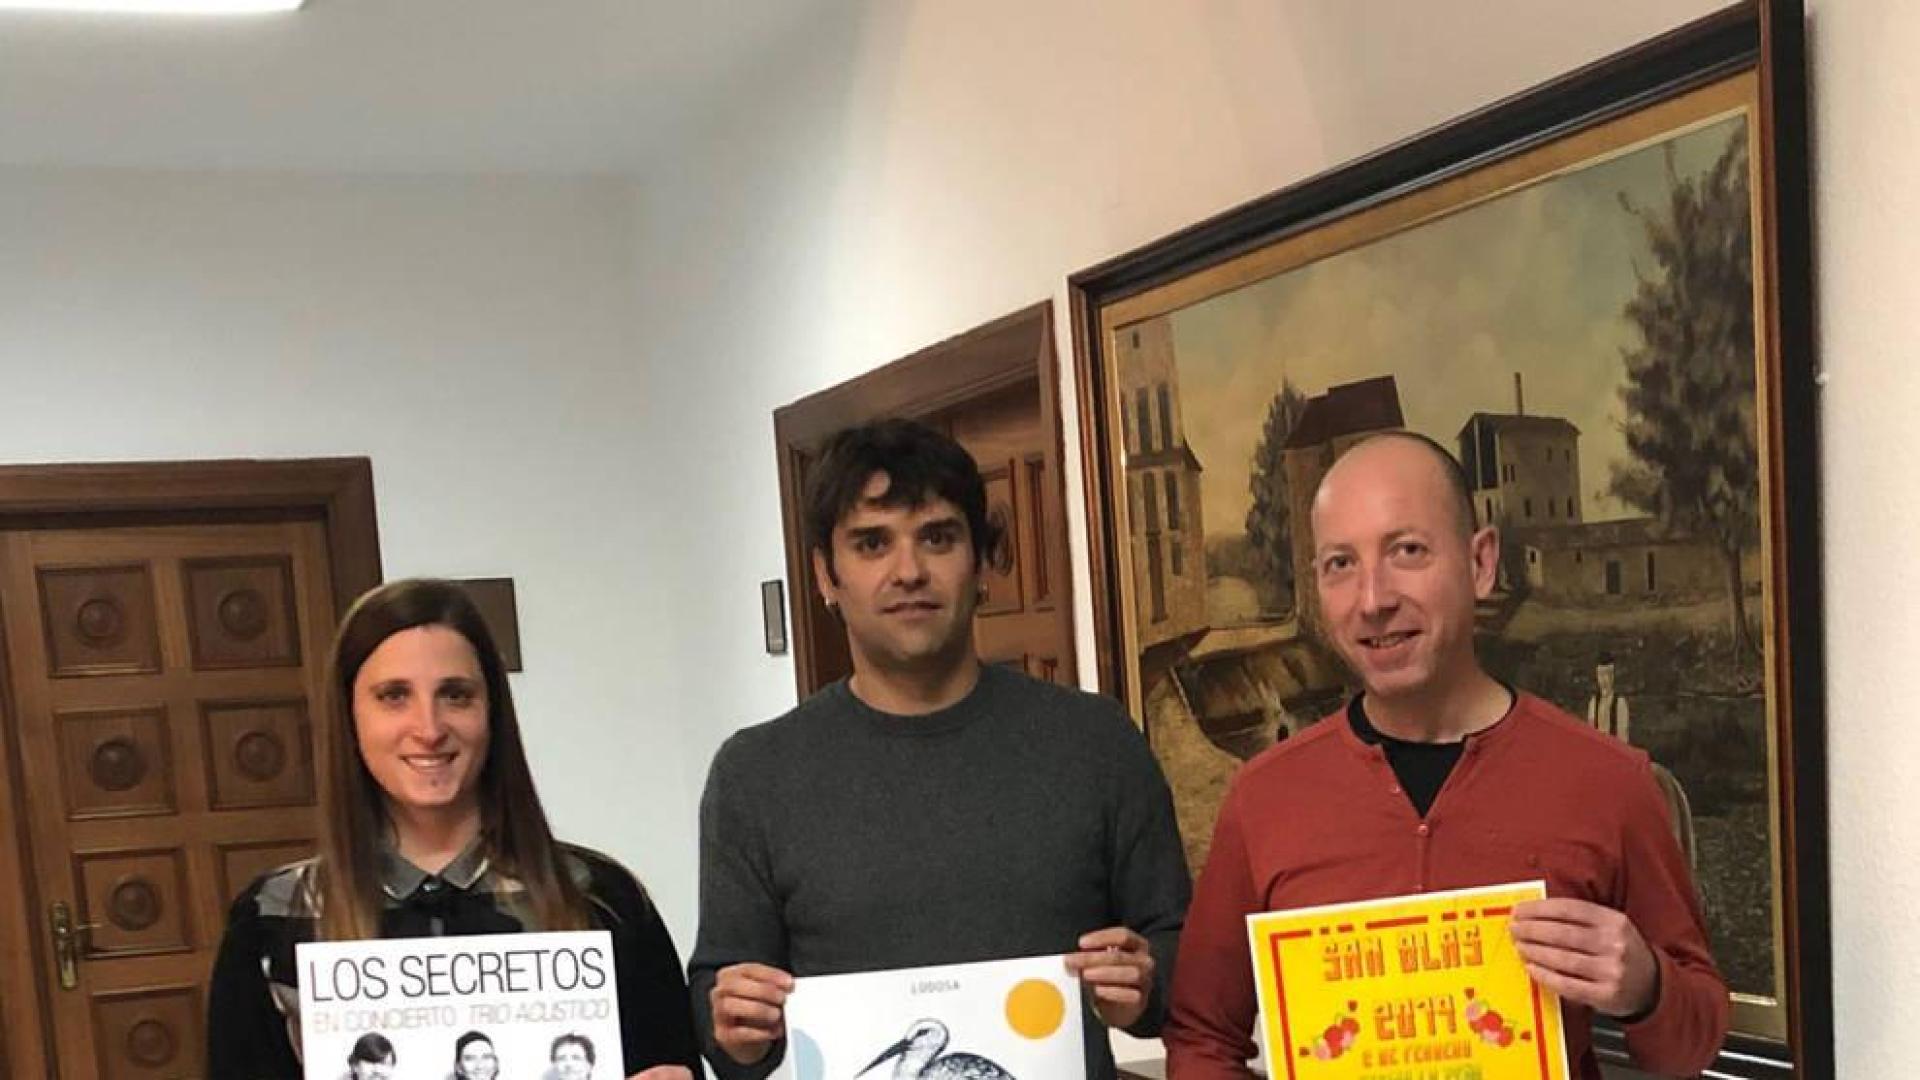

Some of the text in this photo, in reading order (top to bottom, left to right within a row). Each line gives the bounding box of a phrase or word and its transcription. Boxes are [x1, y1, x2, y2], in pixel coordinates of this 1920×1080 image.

[310, 946, 606, 1002] LOS SECRETOS
[1324, 924, 1484, 982] SAN BLAS
[312, 1010, 340, 1033] EN
[345, 1004, 457, 1031] CONCIERTO
[469, 1002, 511, 1025] TRIO
[1374, 994, 1457, 1041] 2019
